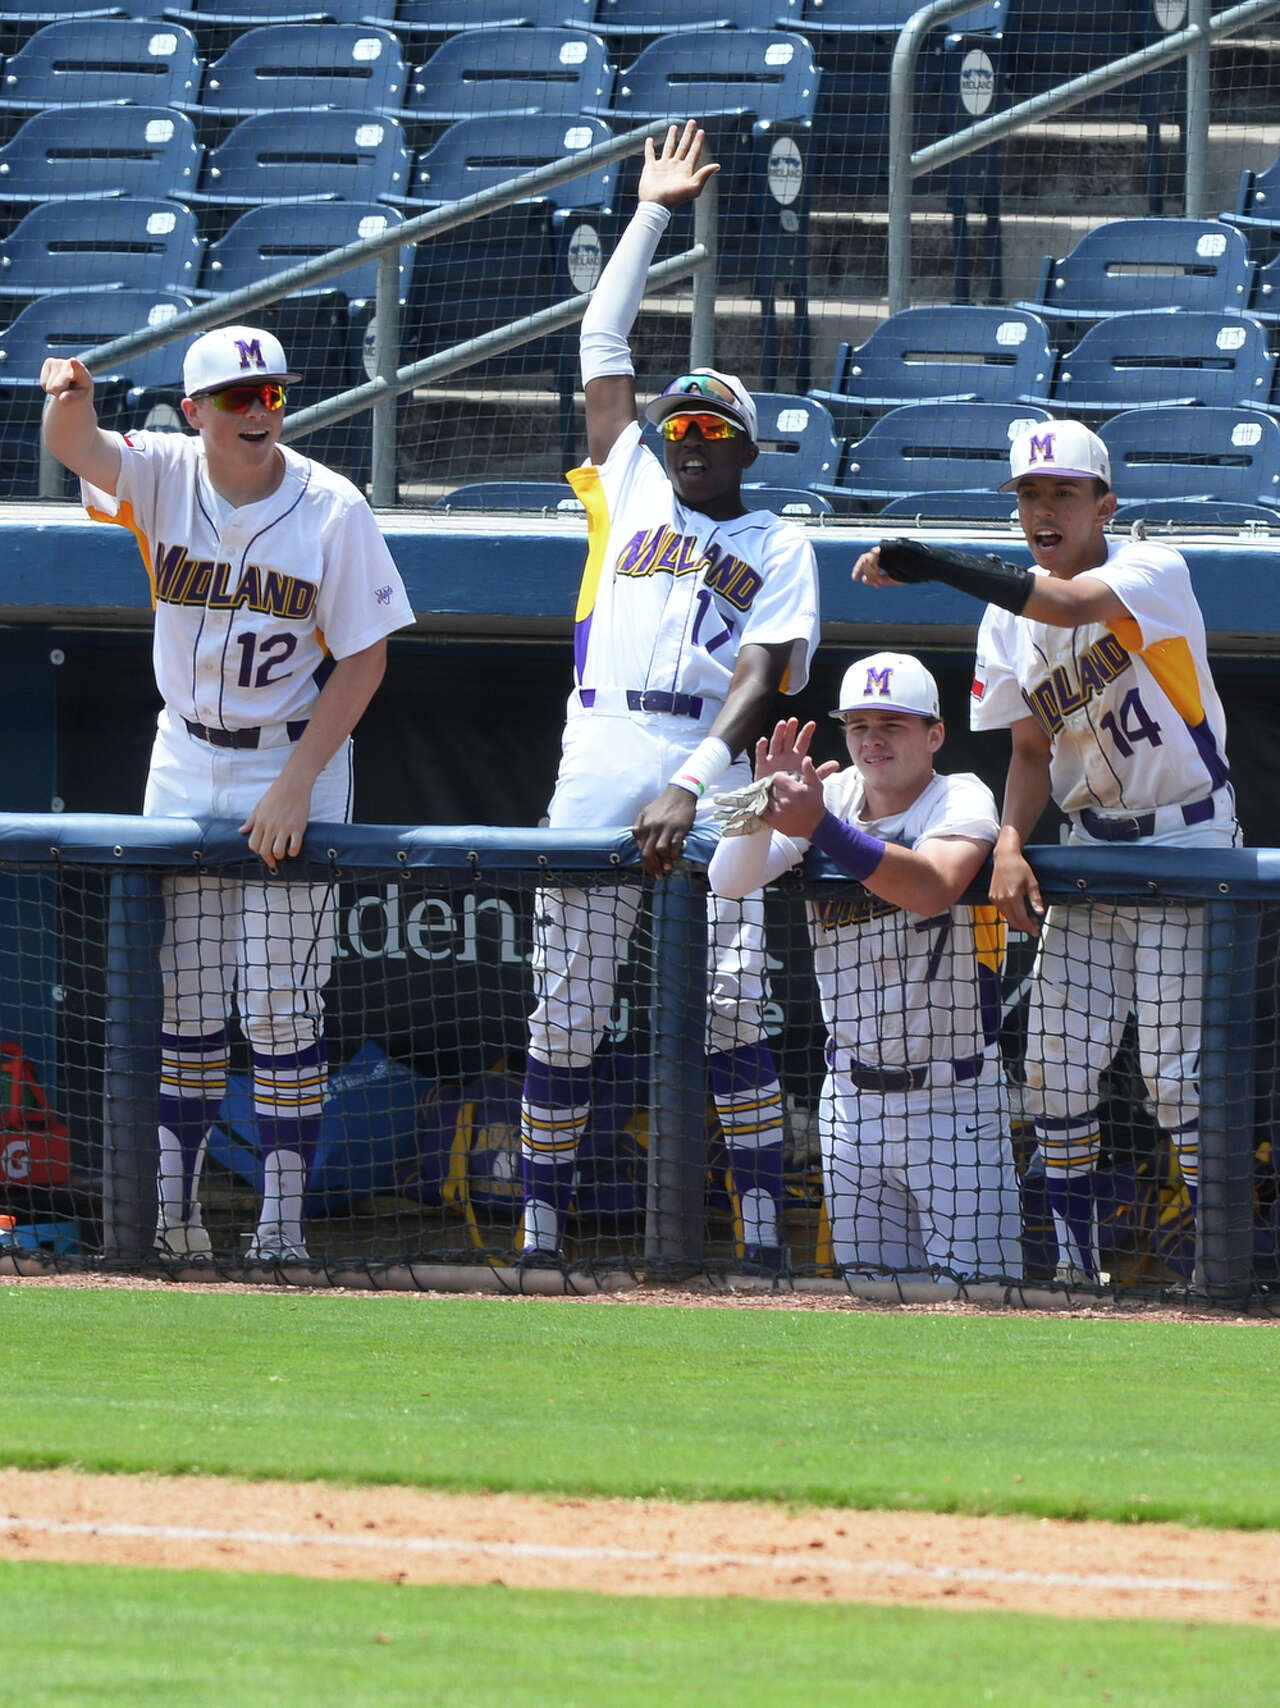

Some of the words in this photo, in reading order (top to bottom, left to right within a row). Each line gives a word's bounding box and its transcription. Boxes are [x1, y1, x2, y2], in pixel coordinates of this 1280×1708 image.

[234, 338, 267, 369] M
[1029, 432, 1056, 464] M
[156, 542, 319, 620] MIDLAND
[237, 631, 299, 689] 12
[863, 666, 894, 697] M
[1021, 633, 1134, 745] DLAND
[1100, 687, 1163, 759] 14
[914, 912, 952, 982] 7
[2, 1140, 31, 1179] G
